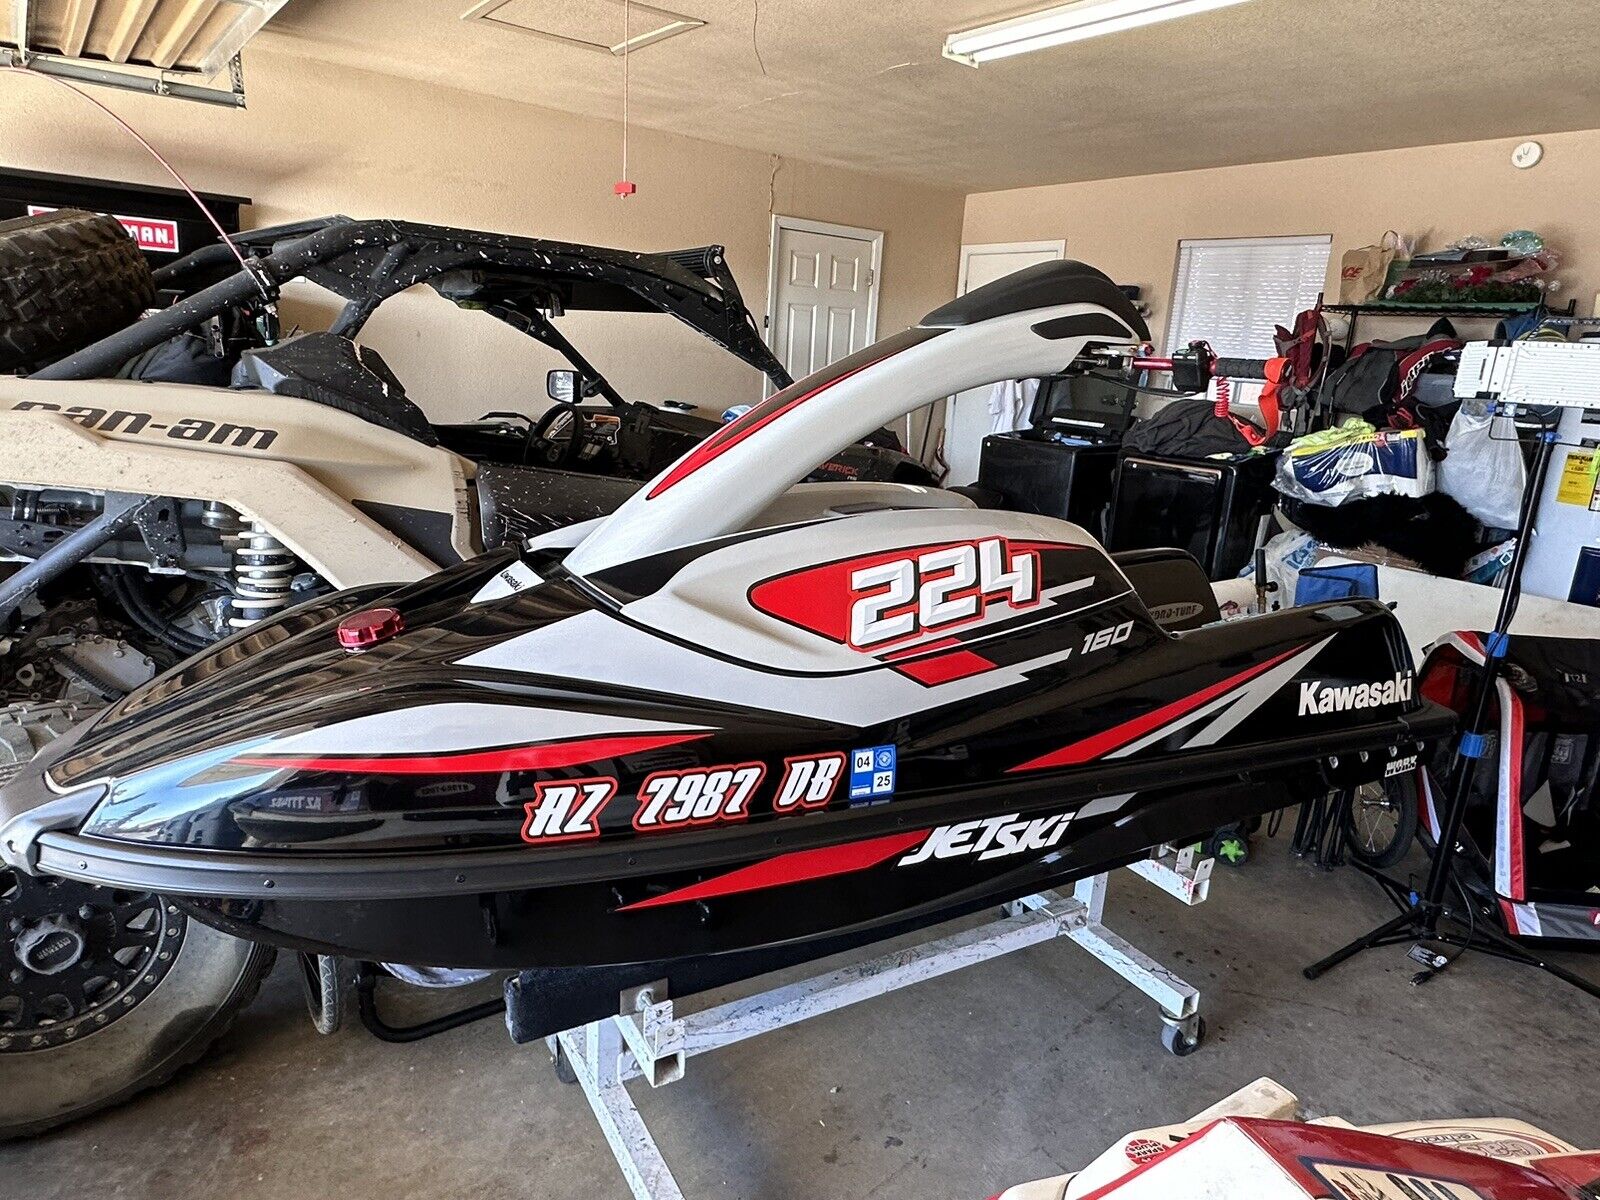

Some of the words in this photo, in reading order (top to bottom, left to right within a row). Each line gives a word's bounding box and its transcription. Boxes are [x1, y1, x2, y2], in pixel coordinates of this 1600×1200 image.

[850, 538, 1033, 648] 224
[1080, 620, 1135, 655] 160
[1298, 670, 1413, 717] Kawasaki
[856, 756, 871, 769] 04
[876, 774, 891, 788] 25
[528, 781, 610, 838] AZ
[638, 767, 762, 826] 7987
